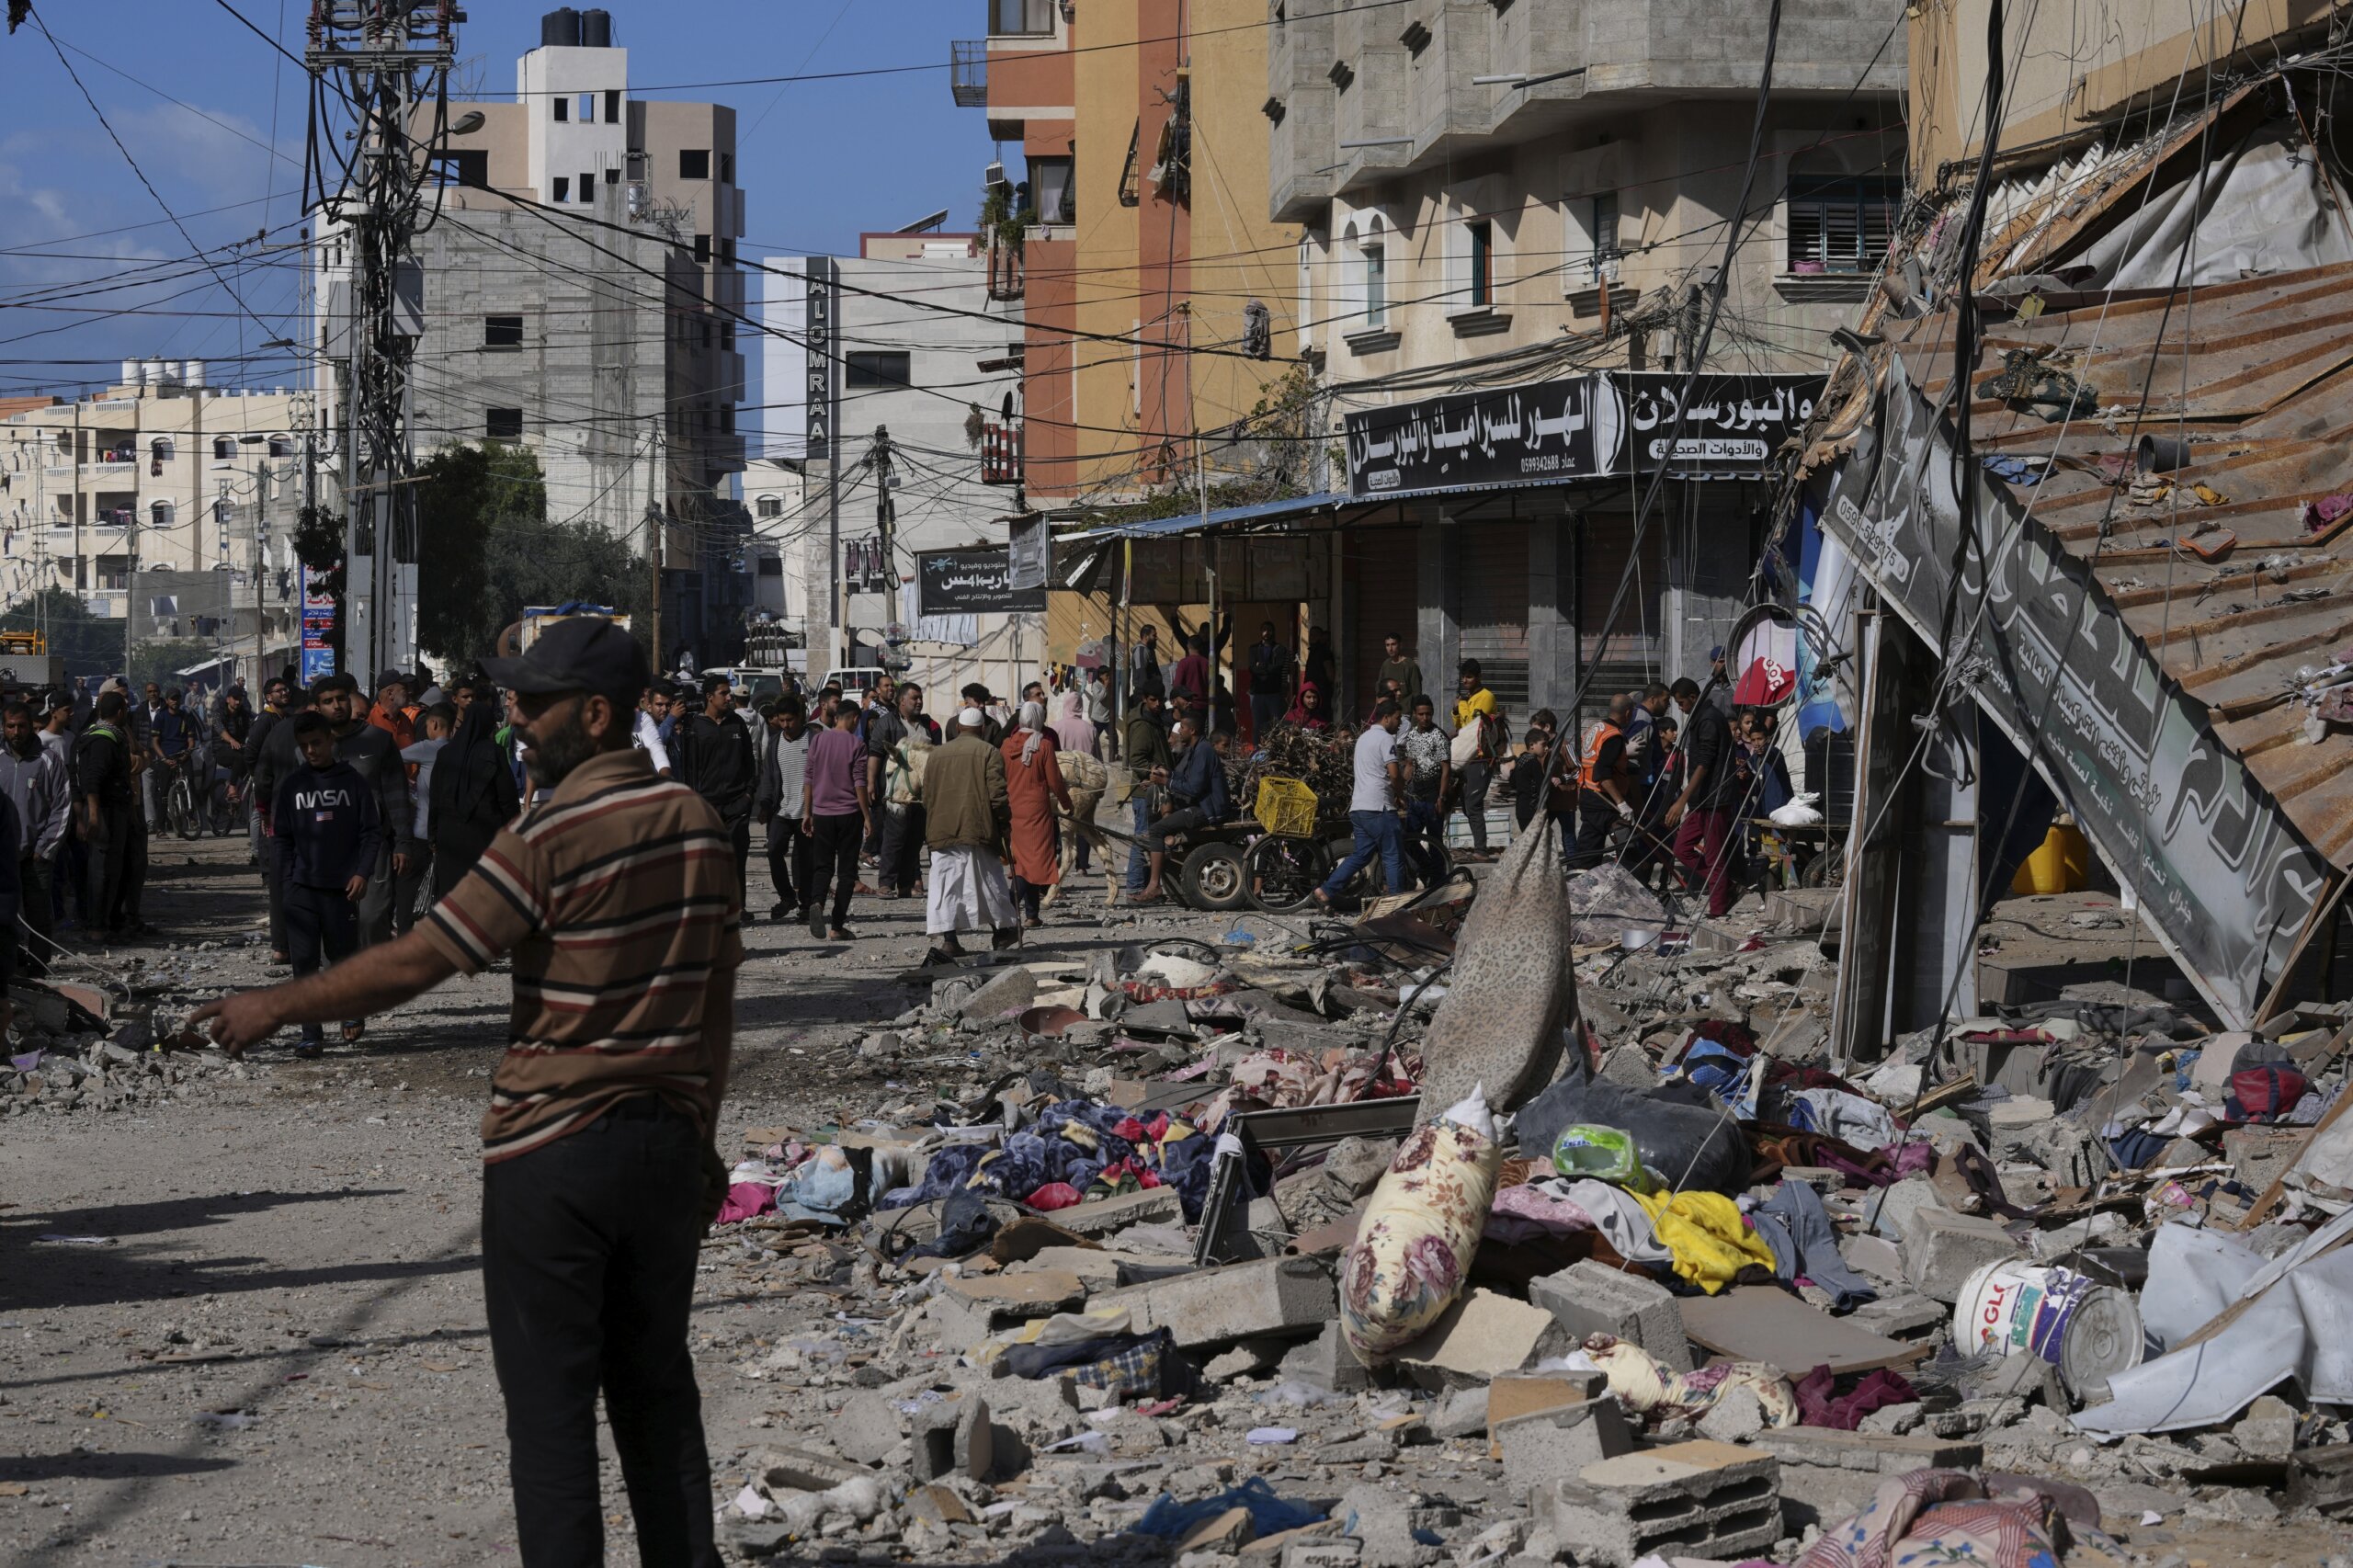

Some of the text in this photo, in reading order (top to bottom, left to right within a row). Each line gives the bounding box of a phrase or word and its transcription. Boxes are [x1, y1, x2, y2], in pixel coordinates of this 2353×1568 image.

[808, 276, 827, 441] ALOMRAA
[1710, 443, 1763, 457] والأدوات
[1520, 454, 1560, 473] 0599342688
[295, 789, 351, 810] NASA
